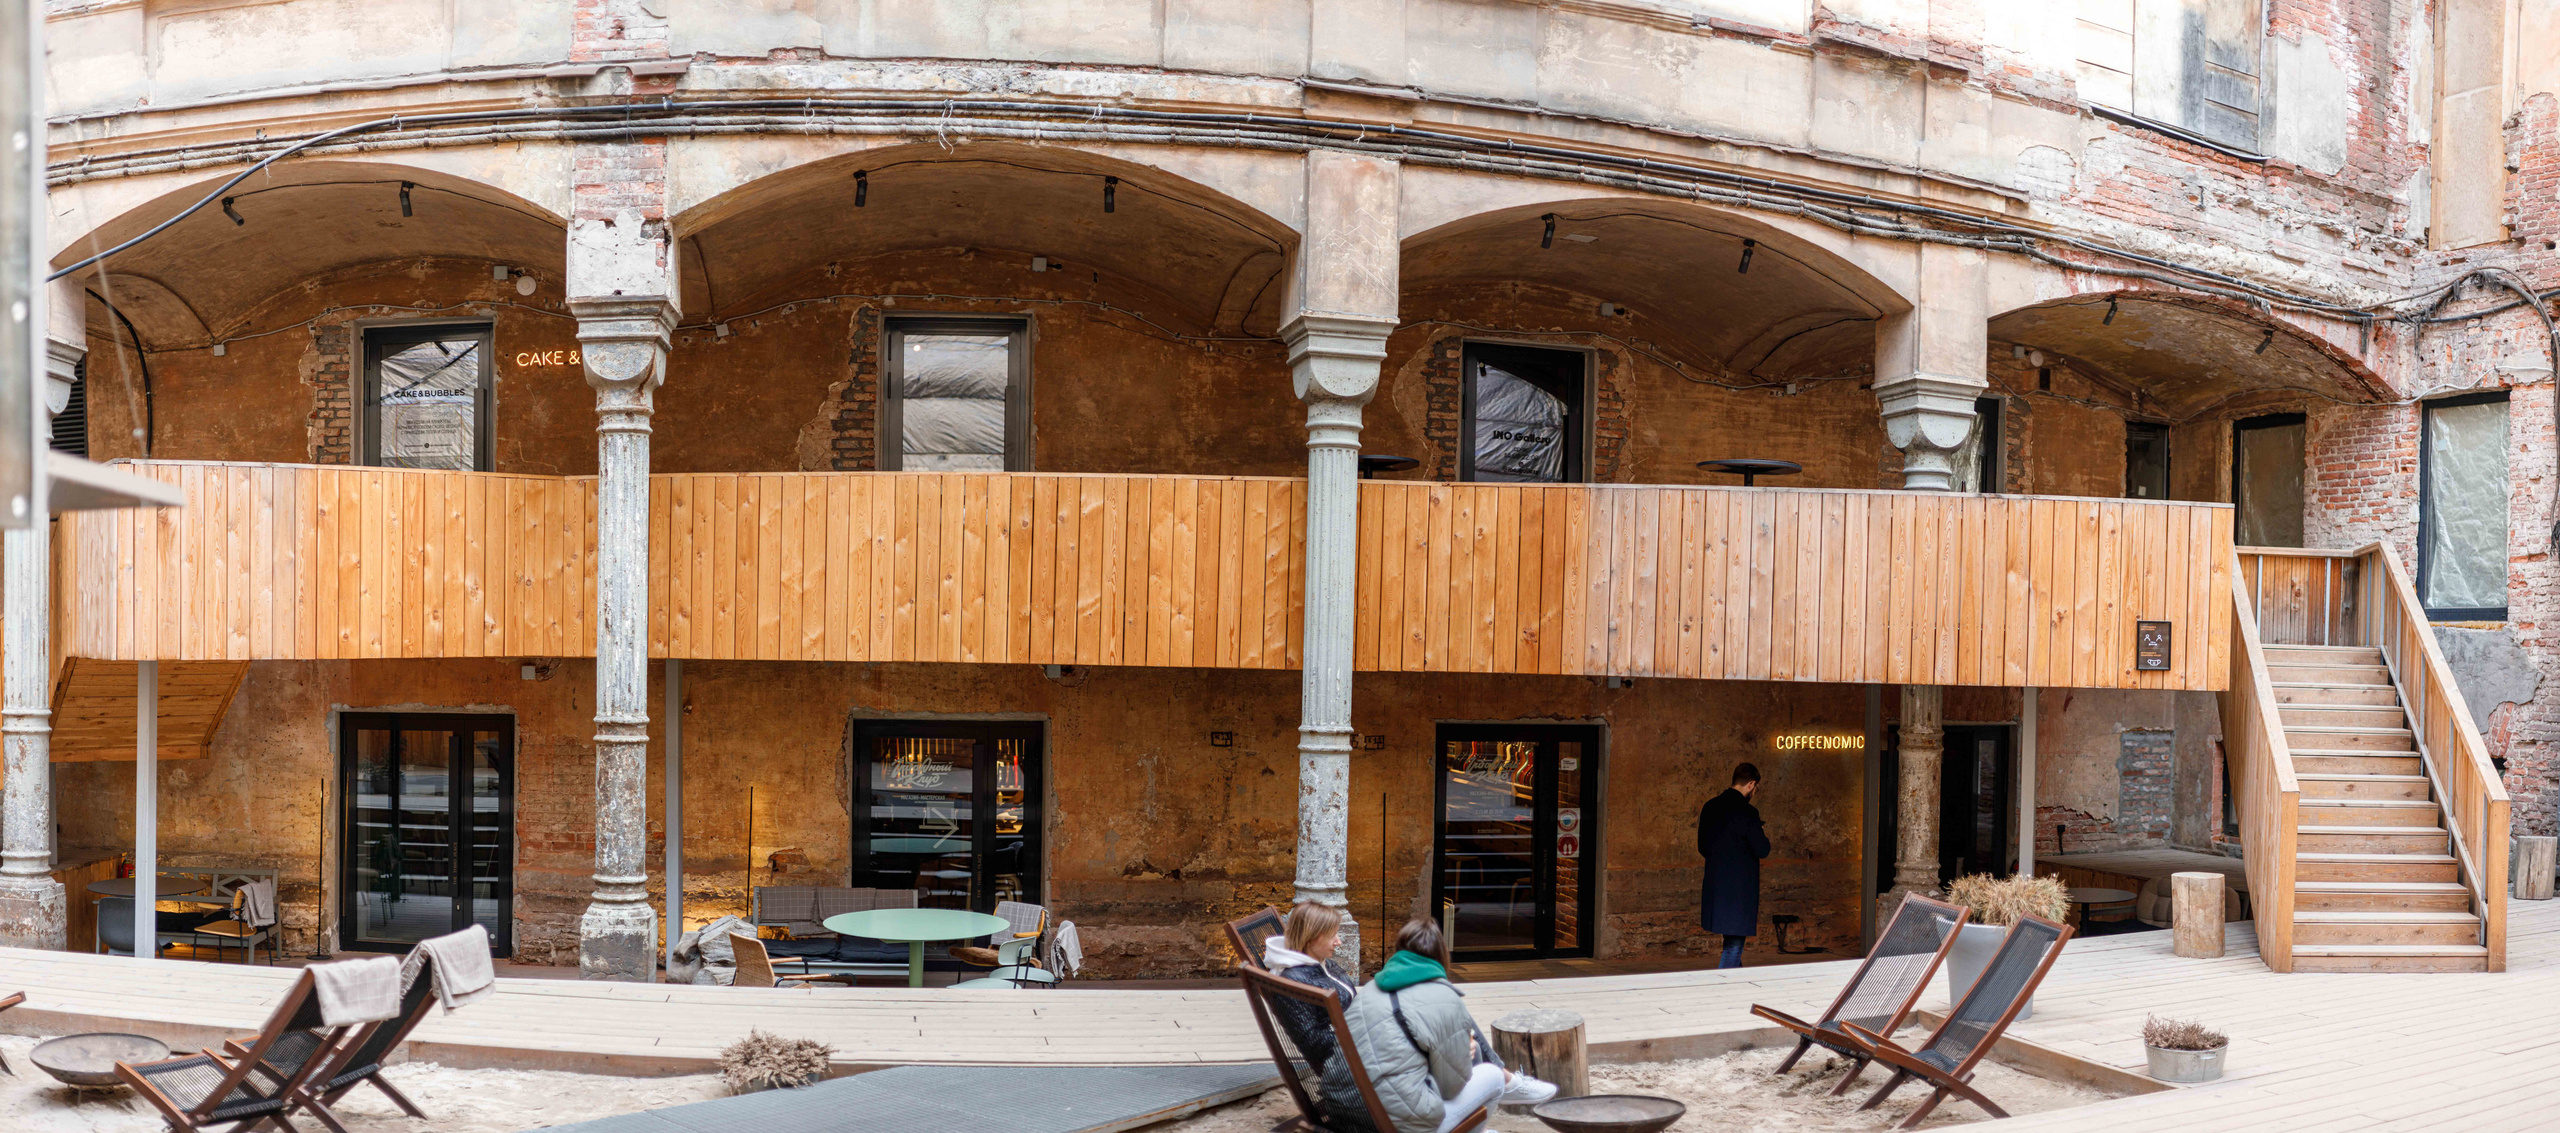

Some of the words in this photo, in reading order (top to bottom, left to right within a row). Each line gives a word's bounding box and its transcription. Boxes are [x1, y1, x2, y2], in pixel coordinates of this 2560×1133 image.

[516, 350, 564, 367] CAKE
[568, 350, 581, 365] &
[1514, 432, 1551, 446] Gallery
[895, 772, 948, 789] Клуб
